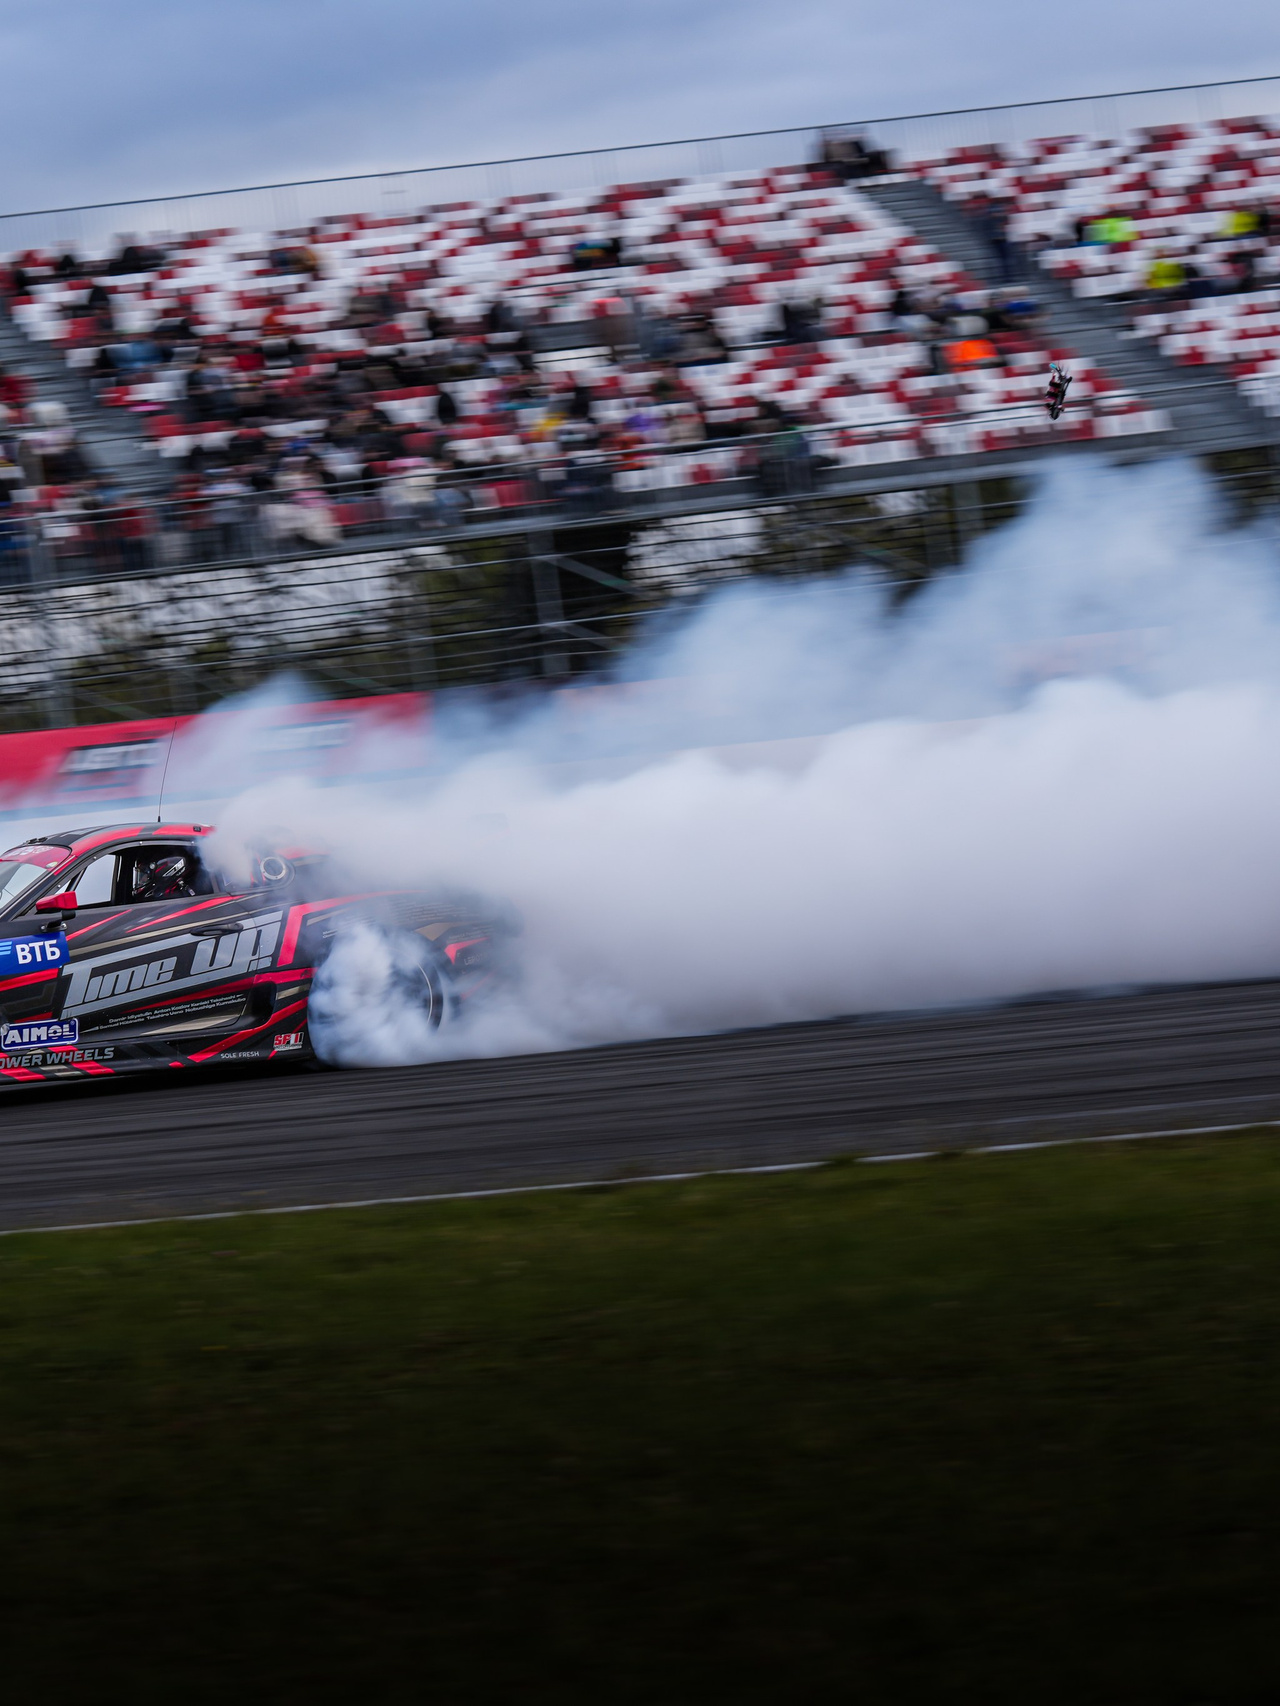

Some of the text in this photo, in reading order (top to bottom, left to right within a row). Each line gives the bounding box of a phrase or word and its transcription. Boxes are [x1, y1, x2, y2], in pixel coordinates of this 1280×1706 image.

[16, 939, 61, 964] ВТБ
[4, 1023, 75, 1045] AIMOL
[46, 1047, 115, 1066] WHEELS
